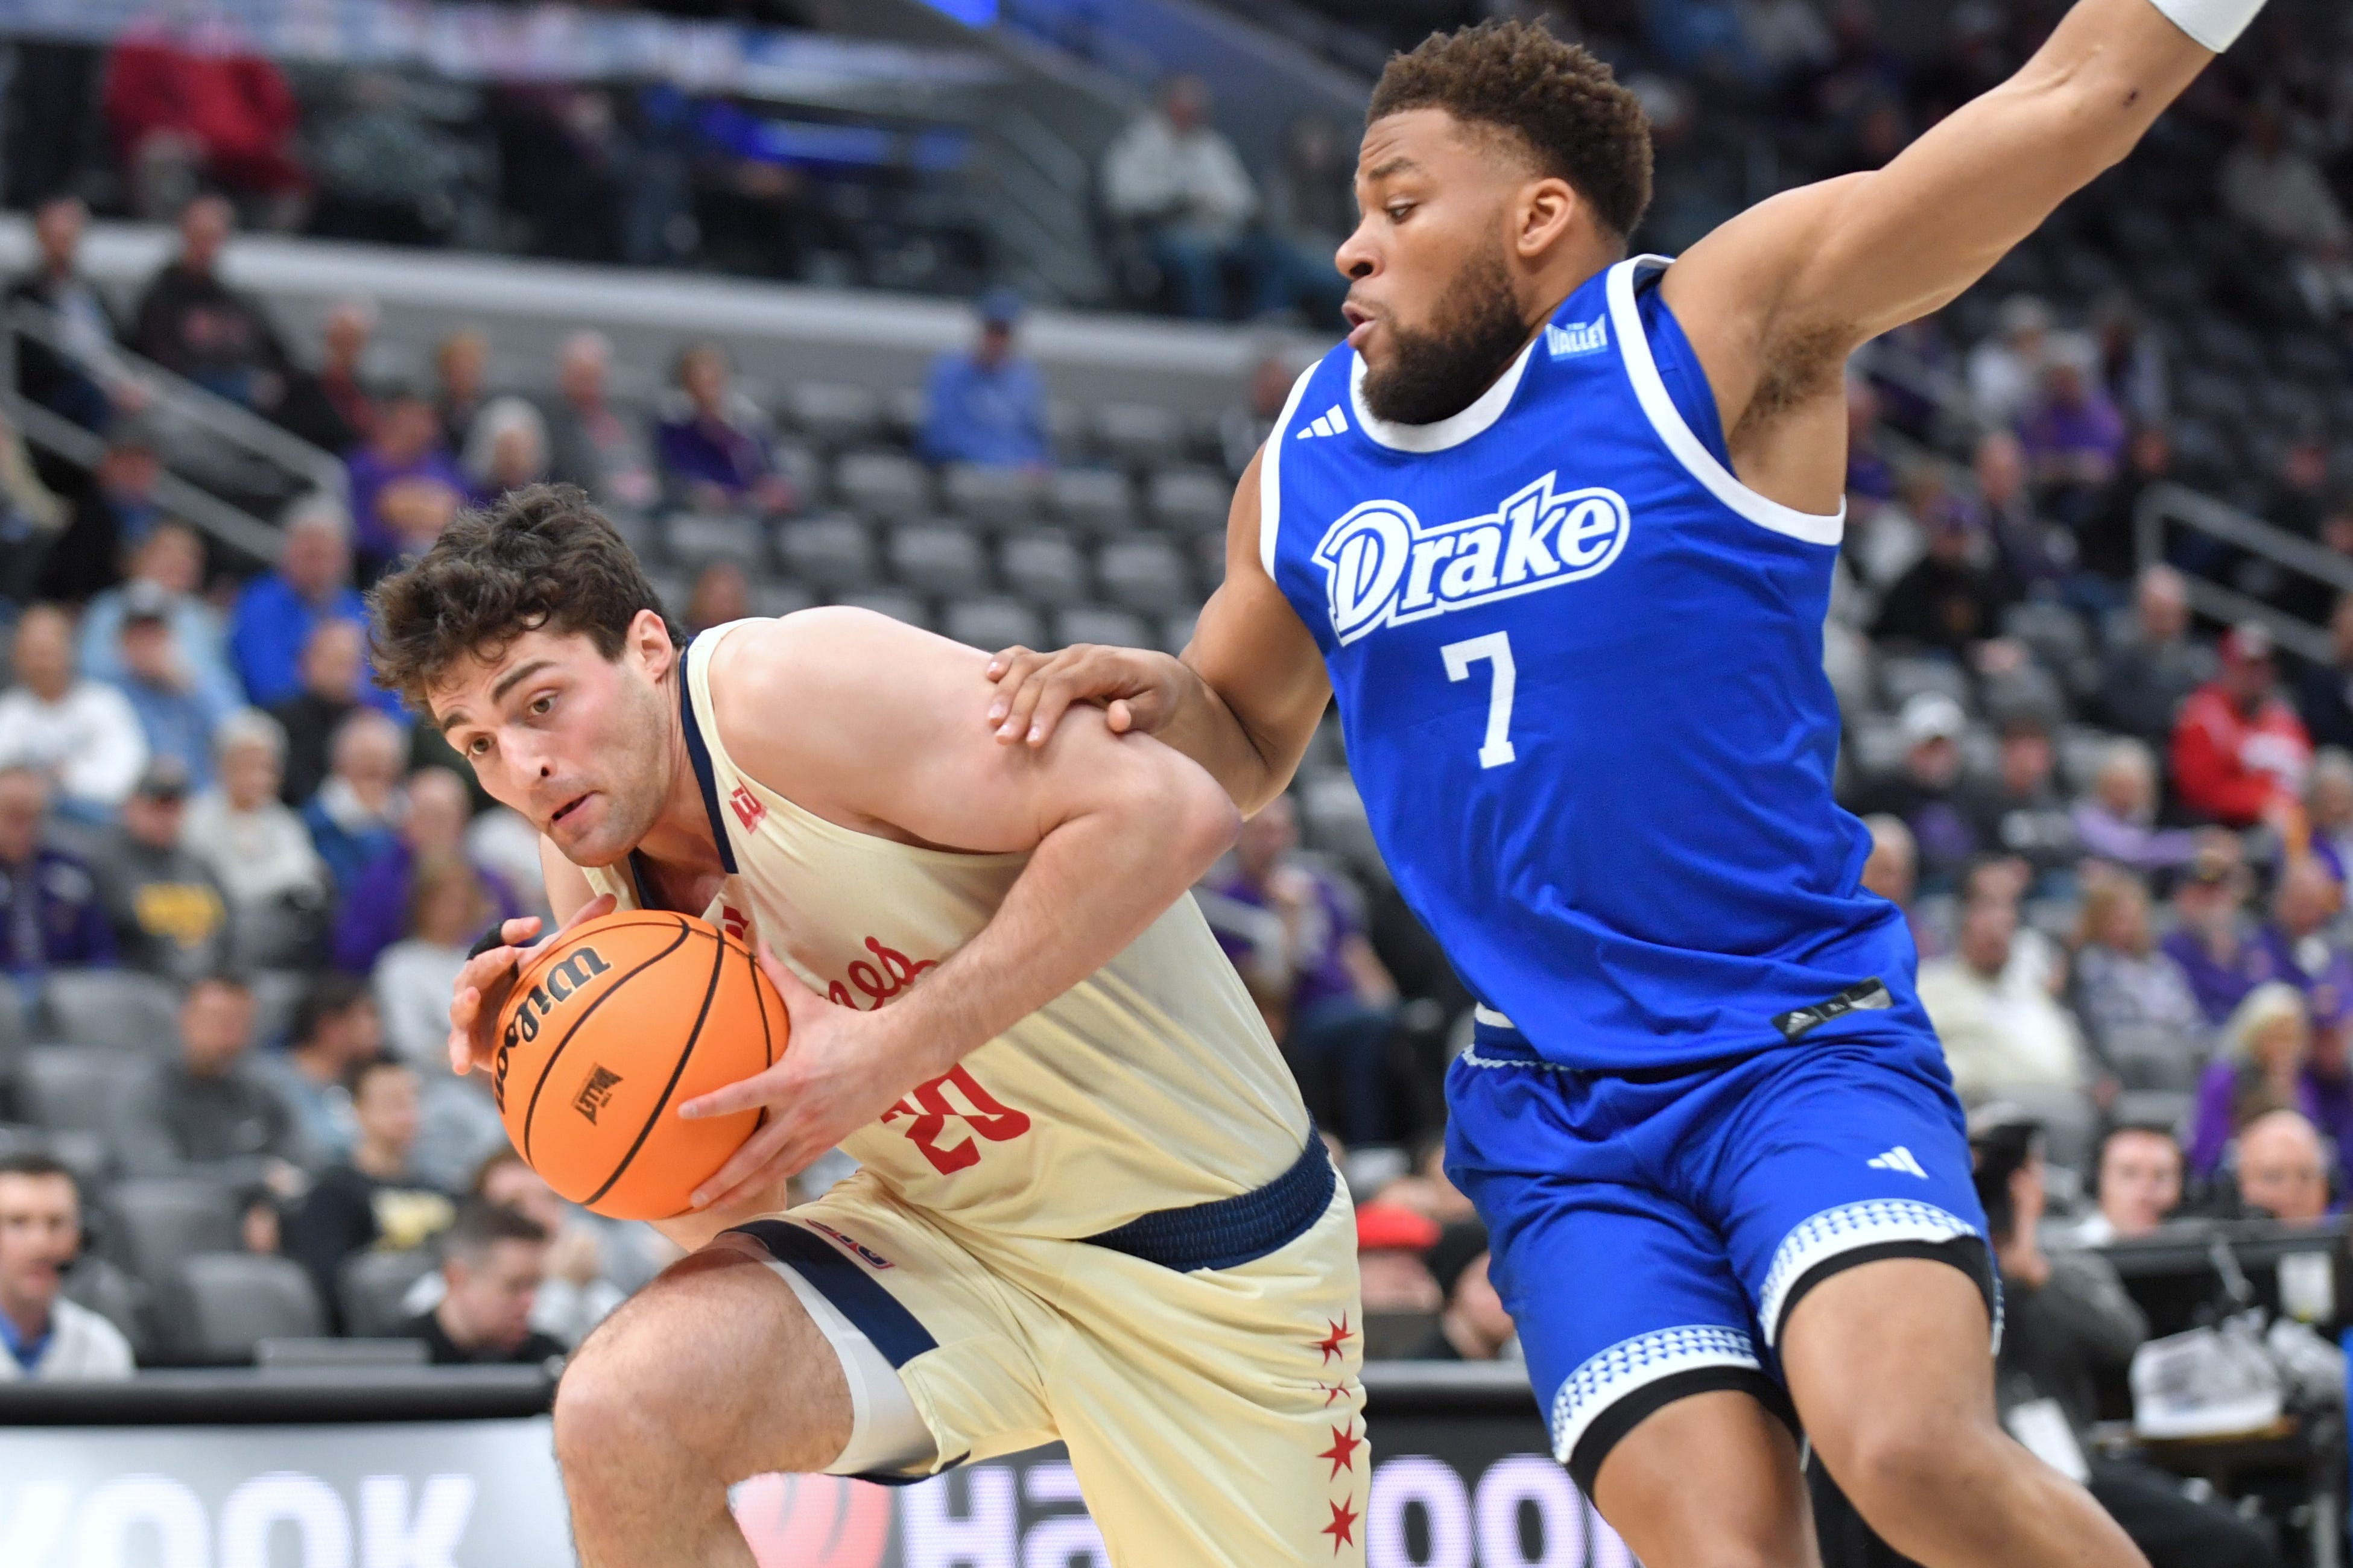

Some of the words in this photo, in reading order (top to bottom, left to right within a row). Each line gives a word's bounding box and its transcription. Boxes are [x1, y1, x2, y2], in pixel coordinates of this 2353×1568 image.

[1545, 313, 1608, 356] VALLEY
[1317, 476, 1627, 642] Drake
[1440, 631, 1516, 769] 7
[497, 947, 612, 1116] Wilson
